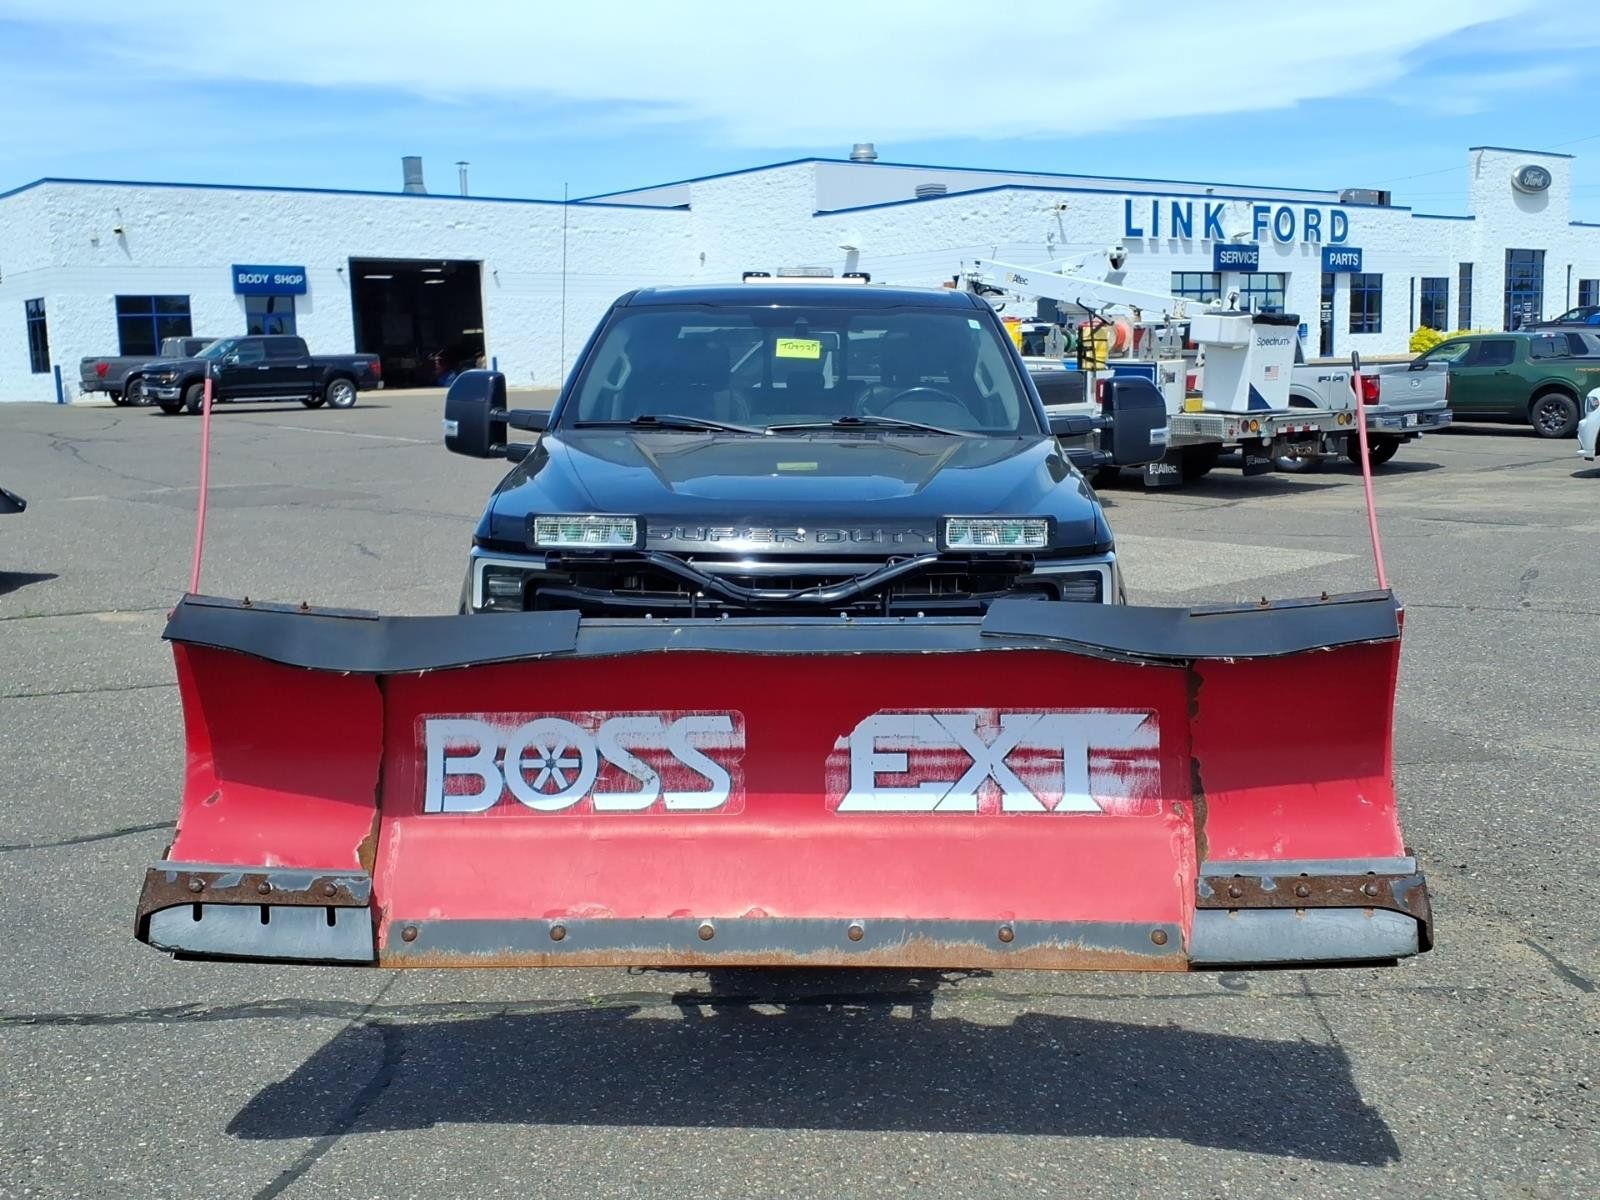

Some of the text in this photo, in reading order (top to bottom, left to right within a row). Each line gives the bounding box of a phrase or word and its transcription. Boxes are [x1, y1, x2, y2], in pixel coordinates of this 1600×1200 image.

[1124, 198, 1350, 244] LINK FORD
[1219, 251, 1259, 265] SERVICE
[1329, 252, 1360, 267] PARTS
[238, 273, 303, 285] BODY SHOP
[1256, 335, 1289, 349] Spectrum
[1158, 463, 1177, 474] Altec
[647, 526, 936, 543] SUPER DUTY
[424, 713, 1149, 813] BOSS EXT
